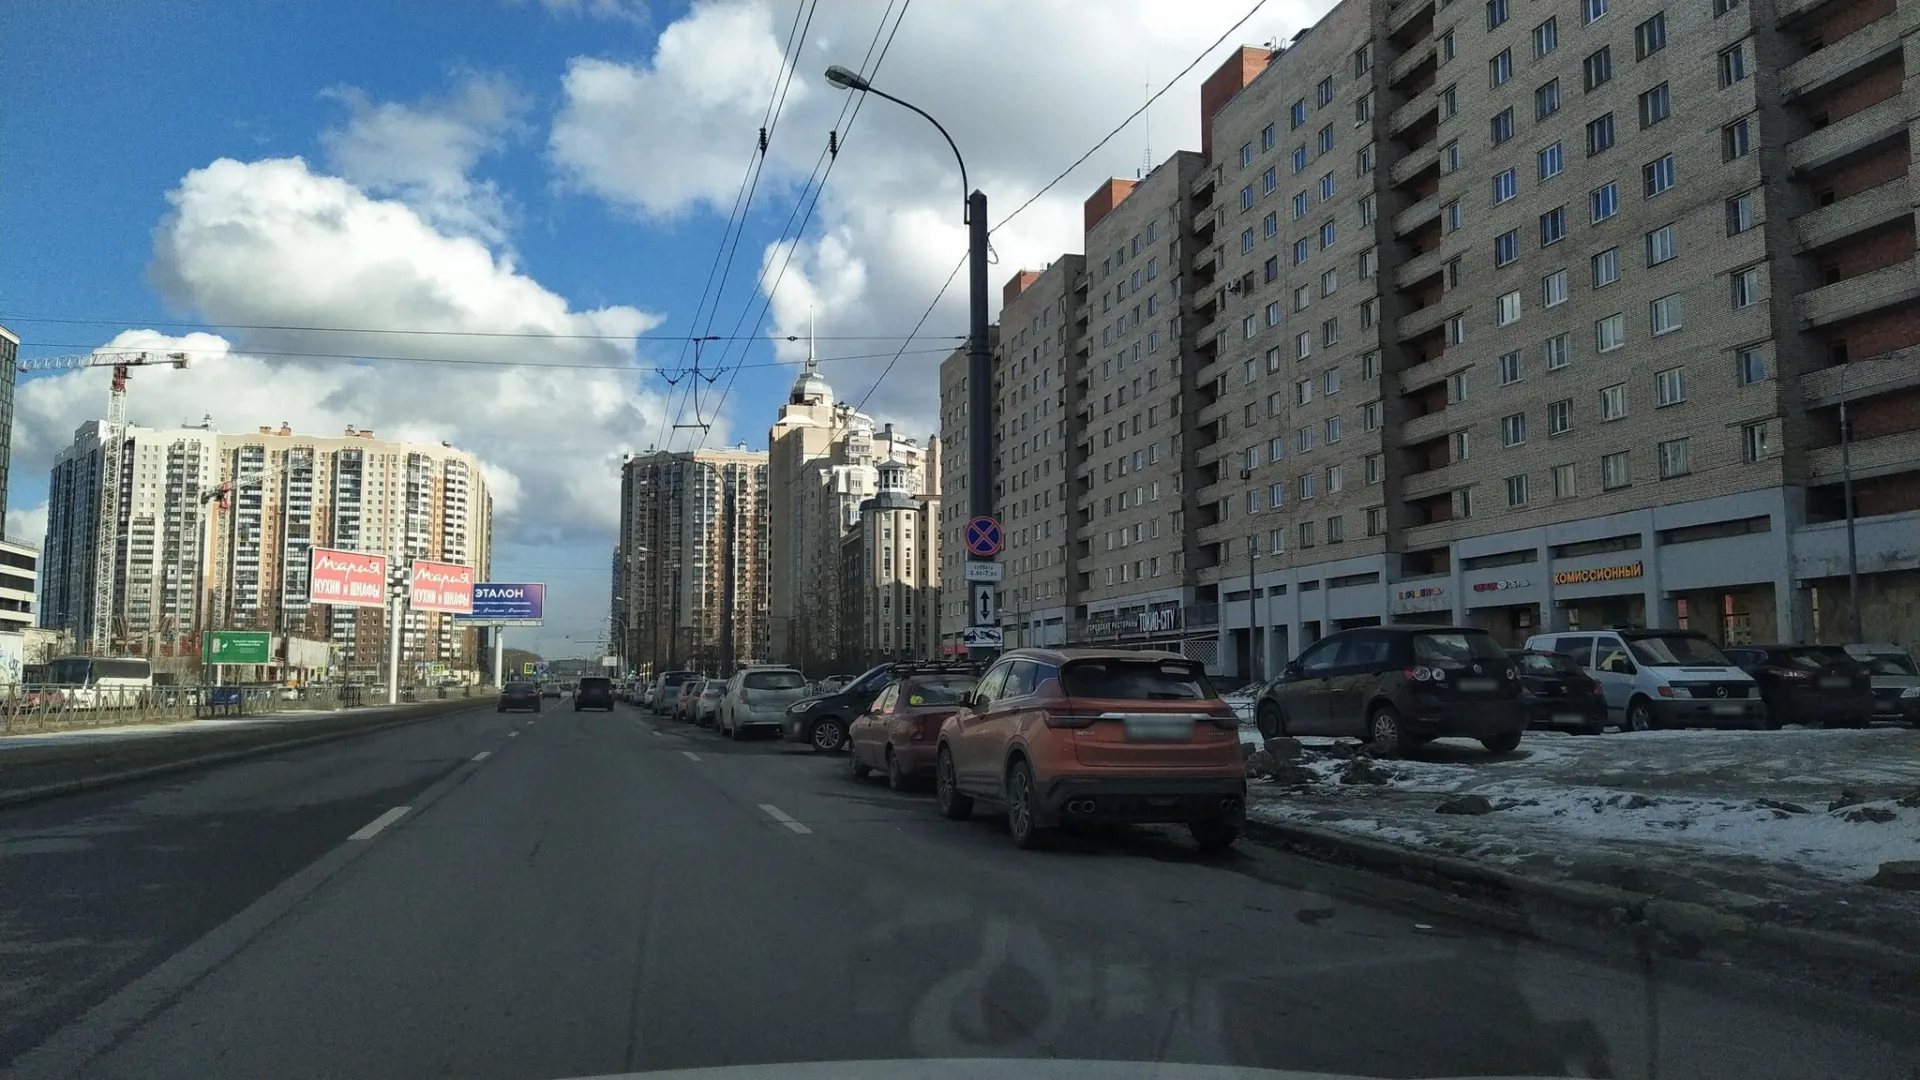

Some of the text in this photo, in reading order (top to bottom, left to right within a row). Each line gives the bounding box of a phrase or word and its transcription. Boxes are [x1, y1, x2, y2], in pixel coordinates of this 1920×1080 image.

[1554, 561, 1643, 585] КОМИССИОННЫЙ
[314, 578, 340, 595] КУХНИ
[350, 581, 380, 598] ШКАФЫ
[414, 588, 436, 603] КУХНИ
[443, 591, 470, 606] ШКАФЫ
[475, 588, 524, 599] ЭТАЛОН
